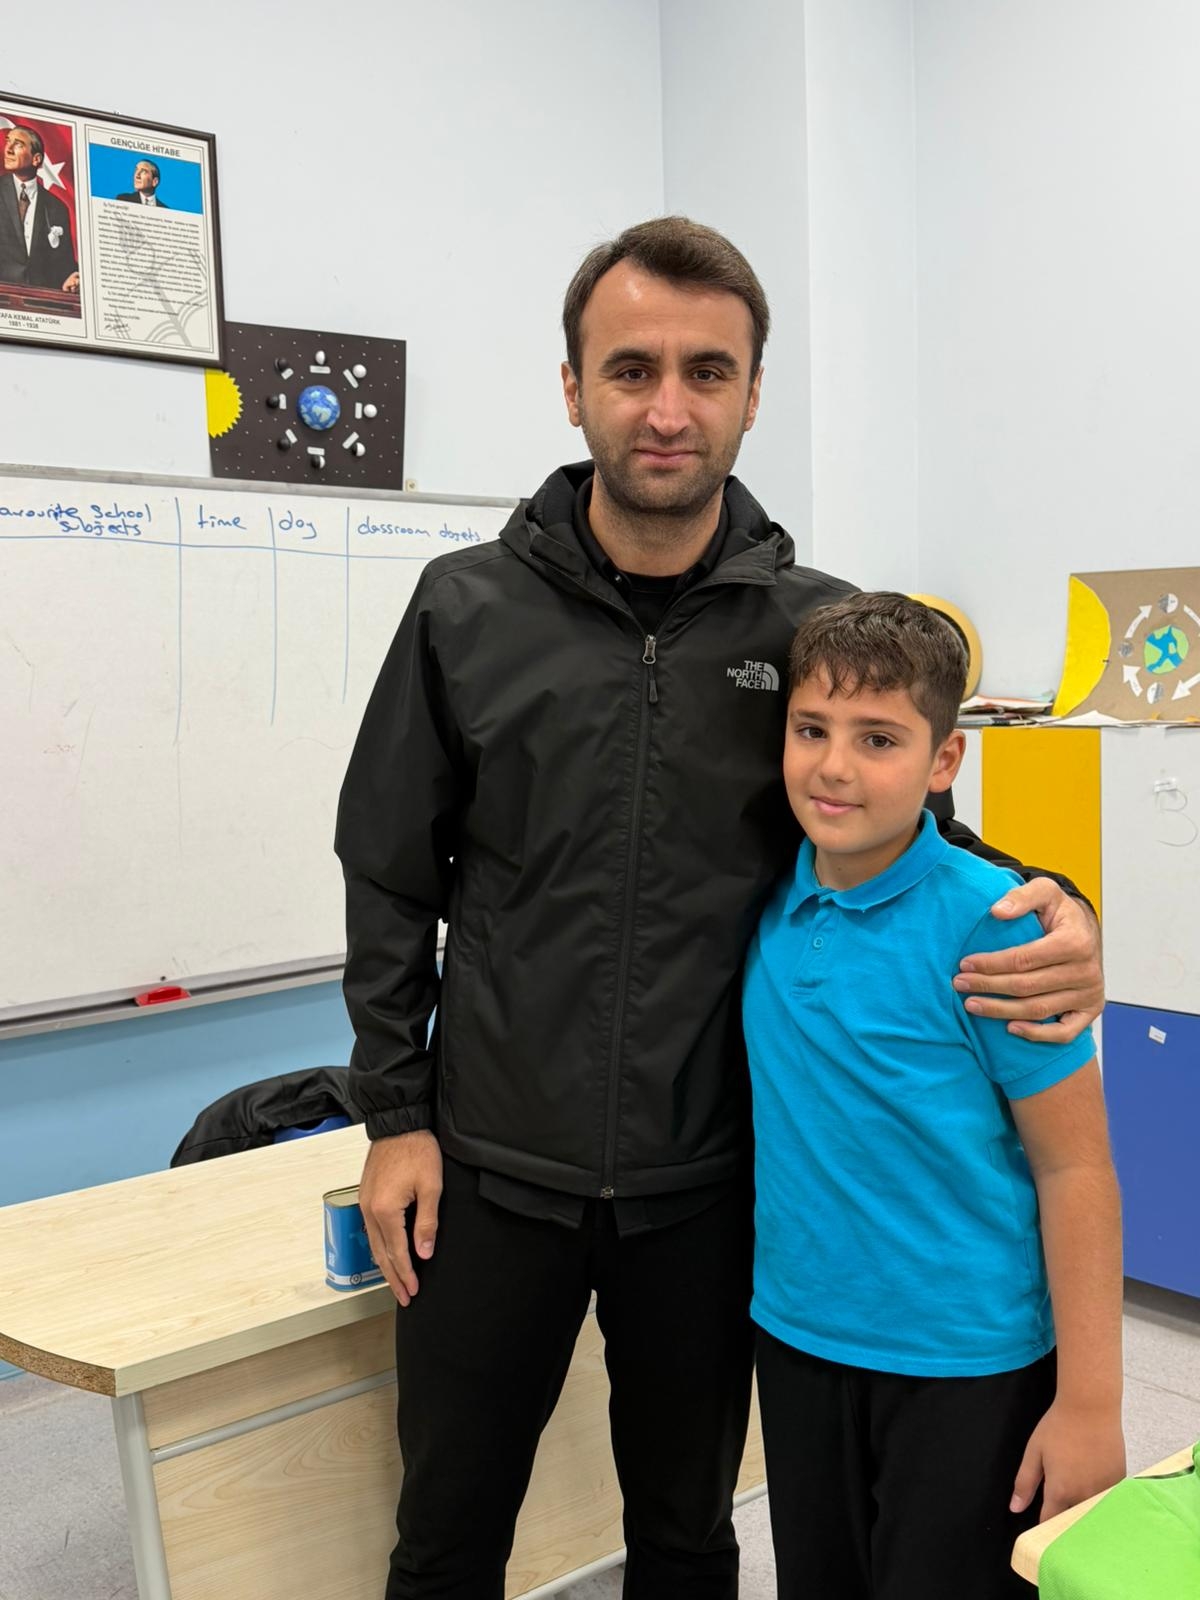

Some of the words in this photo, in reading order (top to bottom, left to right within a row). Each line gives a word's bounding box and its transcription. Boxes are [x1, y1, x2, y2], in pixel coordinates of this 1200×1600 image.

[152, 144, 181, 157] HİTABE
[0, 311, 12, 319] AFA
[13, 313, 33, 322] KEMAL
[0, 502, 79, 521] avourite
[197, 504, 247, 530] time
[744, 660, 764, 671] THE
[726, 667, 762, 681] NORTH
[735, 678, 761, 690] FACE
